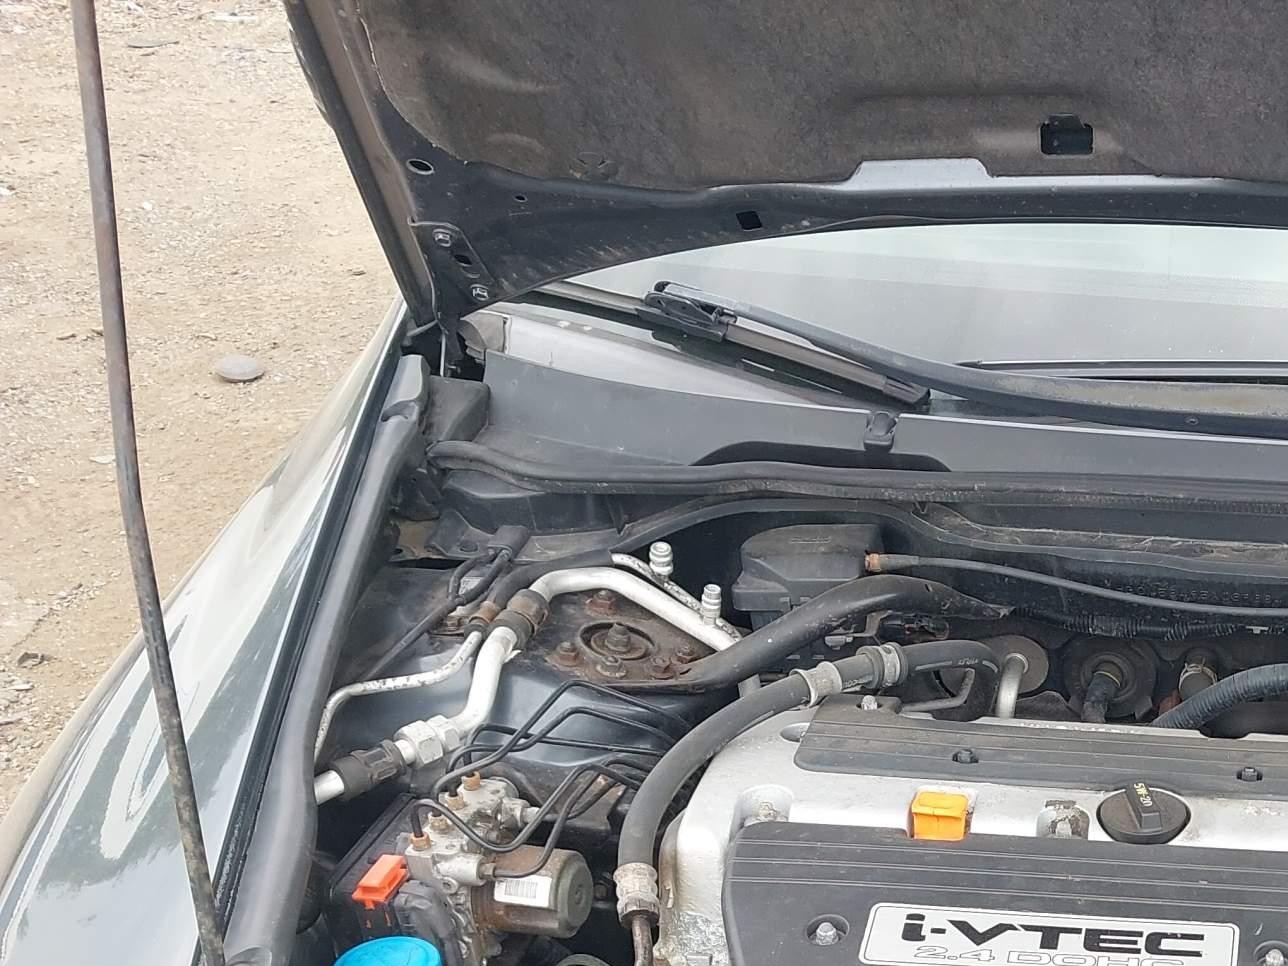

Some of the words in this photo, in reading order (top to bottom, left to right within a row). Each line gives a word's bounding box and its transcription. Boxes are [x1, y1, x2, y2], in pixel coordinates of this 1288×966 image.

[1133, 783, 1153, 807] 5W-20
[901, 912, 1206, 959] i-VTEC
[914, 944, 996, 963] 2.4
